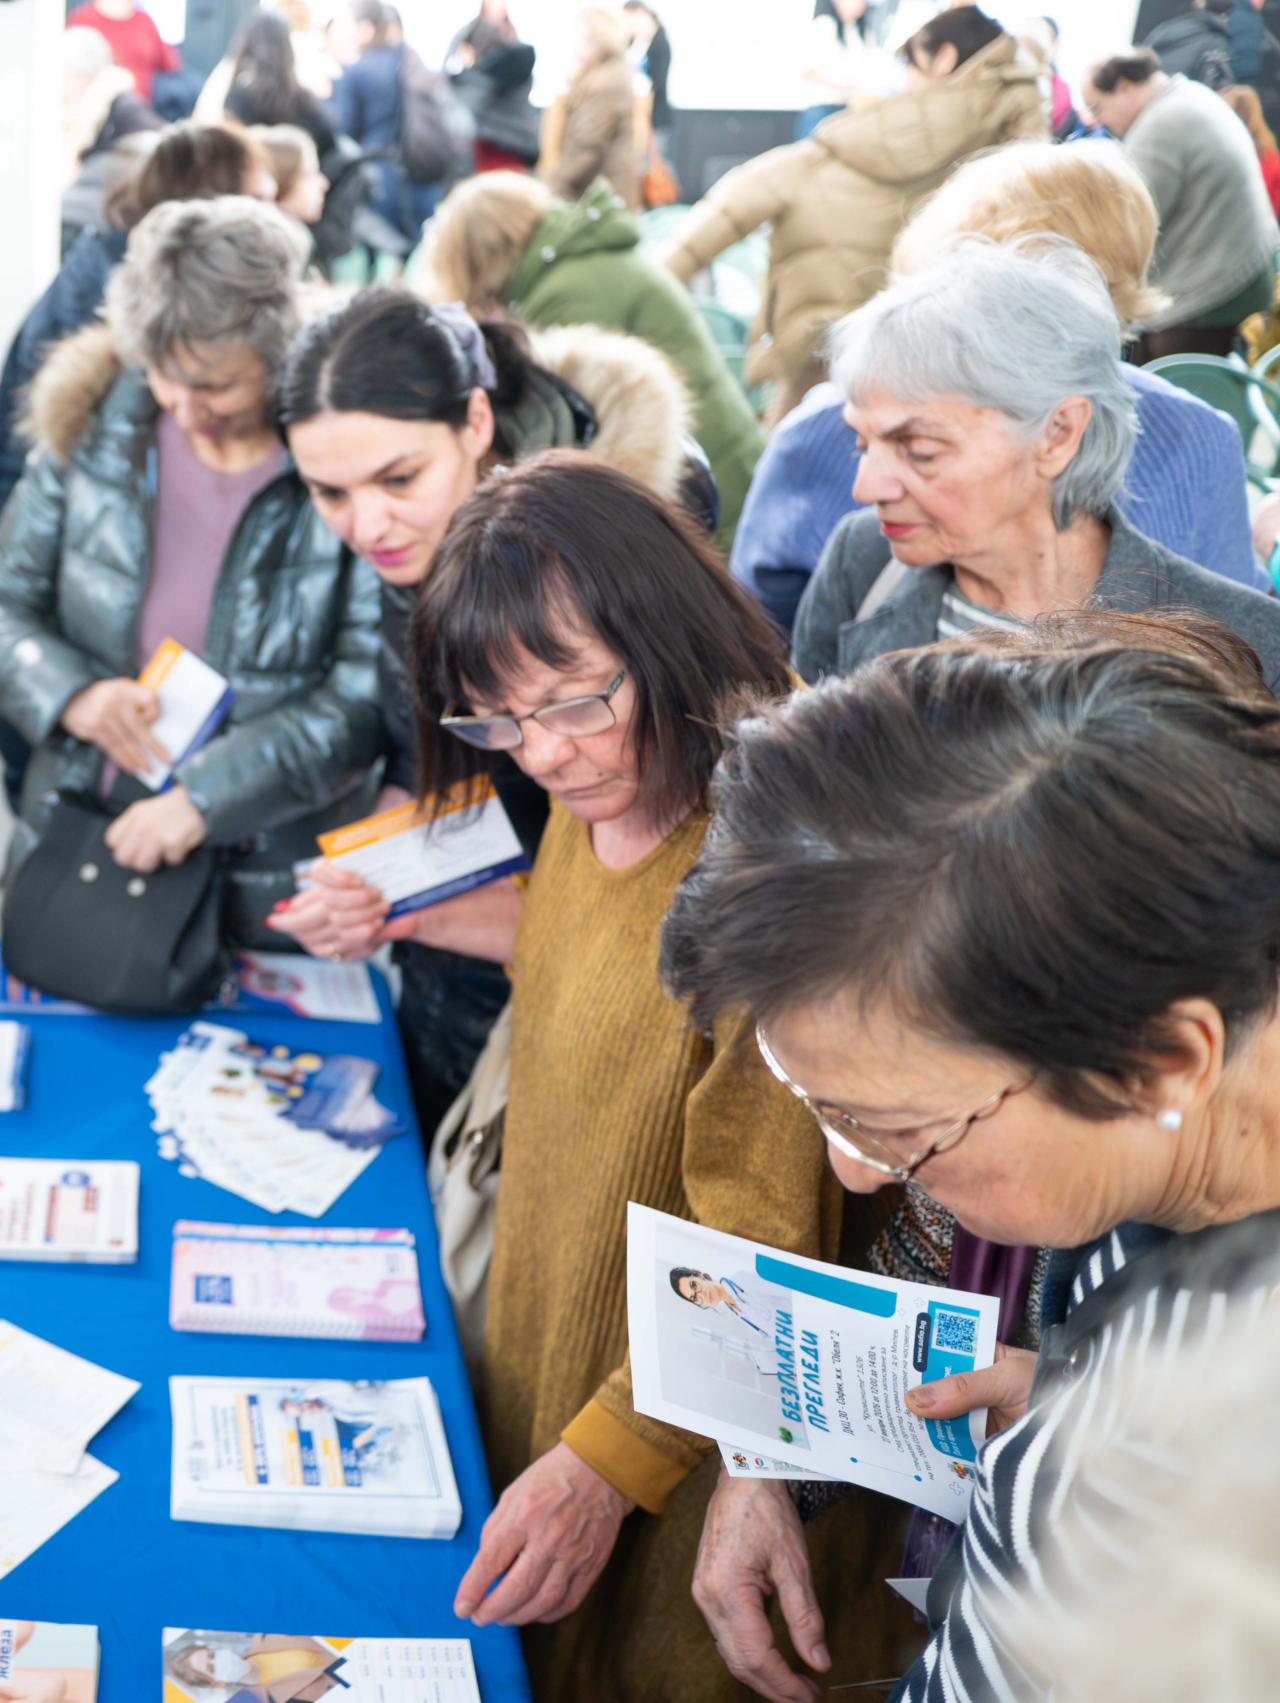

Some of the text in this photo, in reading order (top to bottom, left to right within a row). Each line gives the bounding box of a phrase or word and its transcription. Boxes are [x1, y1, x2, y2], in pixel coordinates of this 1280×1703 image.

[902, 1324, 911, 1359] часовете
[917, 1319, 927, 1363] www.sofia.bg
[868, 1351, 877, 1368] 14:00
[880, 1347, 887, 1356] за
[774, 1309, 802, 1423] БЕЗПЛАТНИ
[902, 1359, 908, 1370] на
[799, 1330, 830, 1433] ПРЕГЛЕДИ
[871, 1370, 878, 1378] до
[835, 1382, 846, 1406] София,
[870, 1377, 879, 1395] 12:00
[873, 1395, 880, 1403] от
[838, 1410, 849, 1421] 30
[872, 1402, 883, 1418] 2026
[883, 1392, 899, 1440] предварително
[840, 1420, 855, 1436] ДКЦ
[894, 1439, 904, 1453] След
[905, 1439, 922, 1472] специалист
[928, 1472, 935, 1481] на
